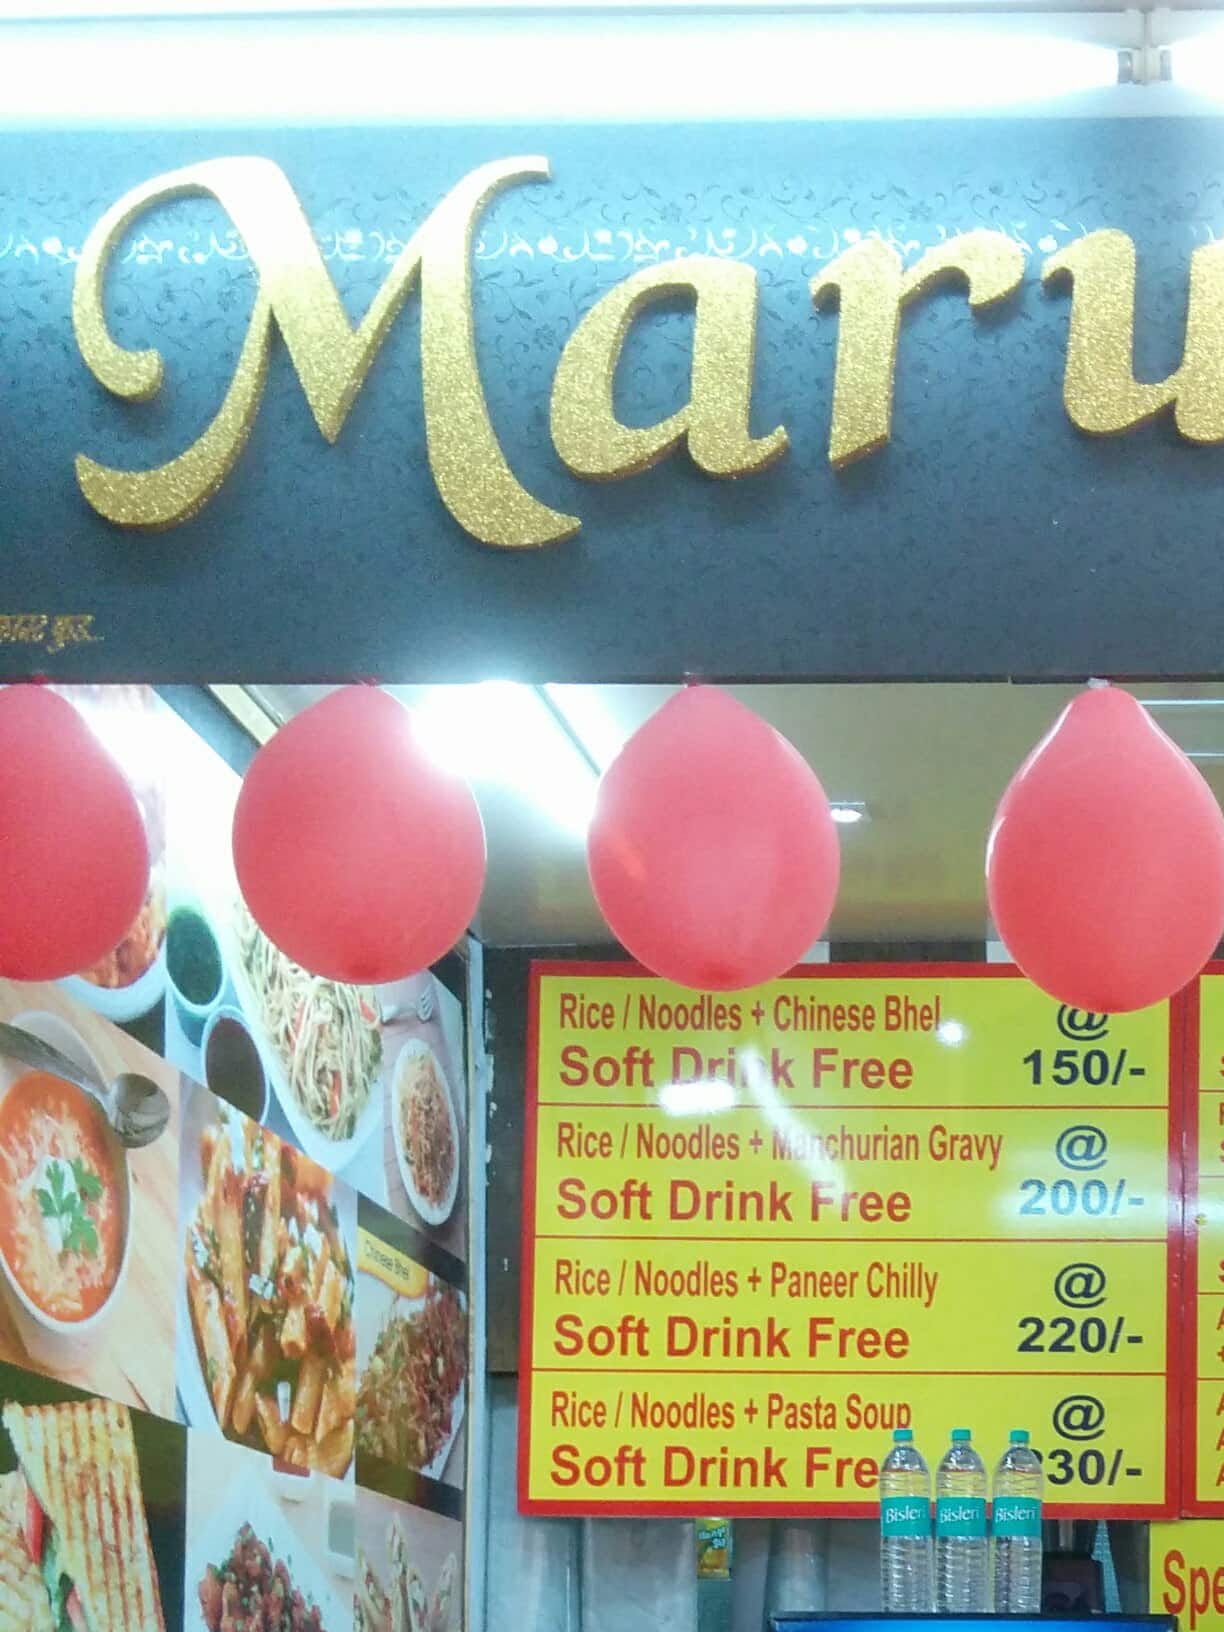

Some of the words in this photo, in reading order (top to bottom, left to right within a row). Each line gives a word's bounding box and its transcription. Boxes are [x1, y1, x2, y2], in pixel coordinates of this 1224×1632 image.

[561, 996, 616, 1031] Rice
[624, 996, 632, 1029] /
[639, 995, 743, 1033] Noodles
[752, 1002, 766, 1027] +
[774, 995, 877, 1033] Chinese
[885, 996, 942, 1033] Bhel
[560, 1045, 656, 1091] Soft
[813, 1047, 915, 1091] Free
[1022, 1049, 1147, 1087] 150/-
[558, 1122, 614, 1160] Rice
[621, 1123, 630, 1159] /
[637, 1123, 742, 1162] Noodles
[749, 1131, 765, 1155] +
[771, 1124, 921, 1163] Manchurian
[929, 1125, 1005, 1173] Gravy
[1056, 1125, 1109, 1173] @
[557, 1178, 654, 1222] Soft
[670, 1180, 795, 1223] Drink
[811, 1181, 913, 1224] Free
[1018, 1178, 1145, 1217] 200/-
[556, 1259, 612, 1298] Rice
[618, 1260, 628, 1298] /
[635, 1260, 740, 1299] Noodles
[747, 1267, 764, 1294] +
[771, 1261, 861, 1300] Paneer
[867, 1262, 940, 1310] Chilly
[1054, 1263, 1109, 1311] @
[554, 1314, 652, 1359] Soft
[667, 1316, 792, 1360] Drink
[809, 1317, 911, 1361] Free
[1017, 1316, 1145, 1355] 220/-
[552, 1391, 609, 1430] Rice
[615, 1392, 625, 1429] /
[631, 1392, 737, 1431] Noodles
[744, 1399, 760, 1426] +
[768, 1393, 838, 1431] Pasta
[846, 1393, 913, 1430] Soup
[1053, 1395, 1107, 1443] @
[552, 1444, 648, 1487] Soft
[664, 1445, 790, 1489] Drink
[806, 1446, 880, 1490] Fre
